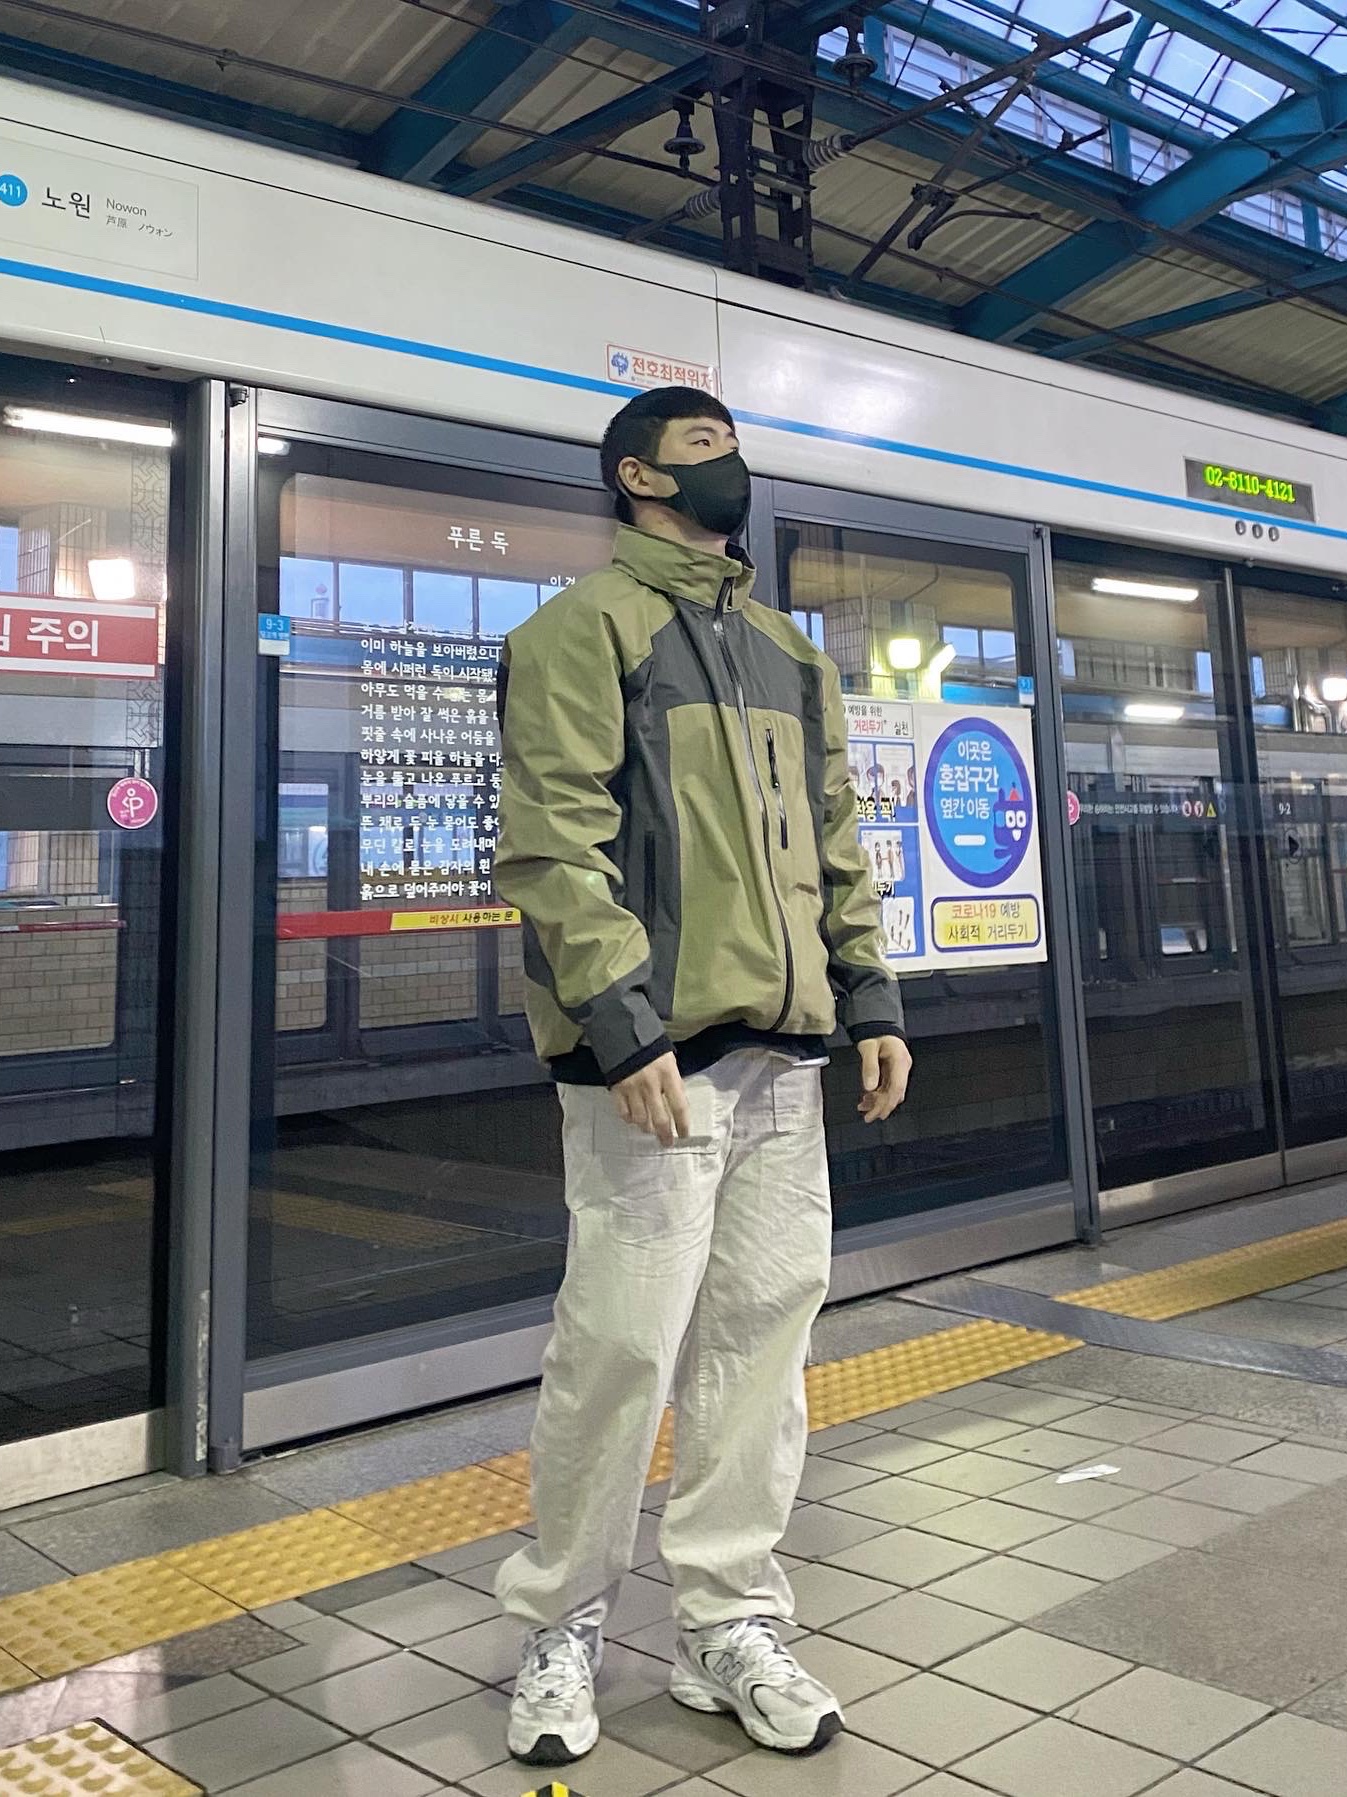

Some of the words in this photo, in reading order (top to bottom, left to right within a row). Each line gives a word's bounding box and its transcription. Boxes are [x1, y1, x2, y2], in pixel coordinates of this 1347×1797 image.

[0, 182, 21, 198] 411
[42, 187, 91, 219] 노원
[106, 198, 147, 217] Nowon
[447, 526, 484, 551] 푸른
[491, 531, 509, 555] 독
[265, 618, 284, 631] 9-3
[27, 617, 98, 657] 주의
[361, 638, 385, 654] 이미
[390, 640, 427, 657] 하늘을
[361, 660, 386, 676] 몸에
[391, 661, 426, 678] 시퍼런
[430, 664, 454, 680] 독이
[361, 682, 400, 698] 아무도
[403, 684, 428, 701] 먹을
[432, 686, 445, 702] 수
[361, 704, 387, 720] 거름
[391, 705, 416, 721] 받아
[420, 707, 433, 722] 잘
[437, 708, 461, 723] 썩은
[466, 708, 489, 725] 흙을
[869, 705, 883, 717] 위한
[361, 726, 387, 742] 핏줄
[391, 727, 416, 743] 속에
[420, 728, 457, 744] 사나운
[461, 730, 496, 746] 어둠을
[894, 720, 909, 736] 실천
[361, 748, 400, 765] 하얗게
[404, 749, 417, 766] 꽃
[449, 751, 485, 767] 하늘을
[958, 740, 992, 761] 이곳은
[361, 771, 387, 787] 눈을
[421, 772, 446, 787] 나온
[450, 773, 486, 788] 푸르고
[939, 763, 999, 793] 혼잡구간
[361, 793, 399, 809] 뿌리의
[403, 794, 440, 809] 슬픔에
[445, 794, 469, 809] 닿을
[473, 794, 485, 809] 수
[1278, 802, 1292, 815] 9-2
[361, 816, 374, 831] 뜬
[379, 816, 403, 832] 채로
[426, 816, 439, 831] 눈
[361, 838, 386, 854] 무딘
[391, 838, 416, 854] 칼로
[420, 837, 446, 854] 눈을
[450, 837, 496, 853] 도려내며
[361, 861, 374, 877] 내
[378, 860, 405, 877] 손에
[438, 859, 474, 875] 감자의
[479, 858, 491, 874] 흰
[360, 883, 400, 901] 흙으로
[404, 881, 465, 899] 덮어주어야
[468, 880, 492, 898] 꽃이
[429, 913, 459, 925] 비상시
[463, 912, 500, 924] 사용하는
[504, 910, 514, 921] 문
[952, 902, 997, 919] 코로나19
[1000, 901, 1020, 918] 예방
[948, 924, 980, 942] 사회적
[987, 922, 1028, 941] 거리두기
